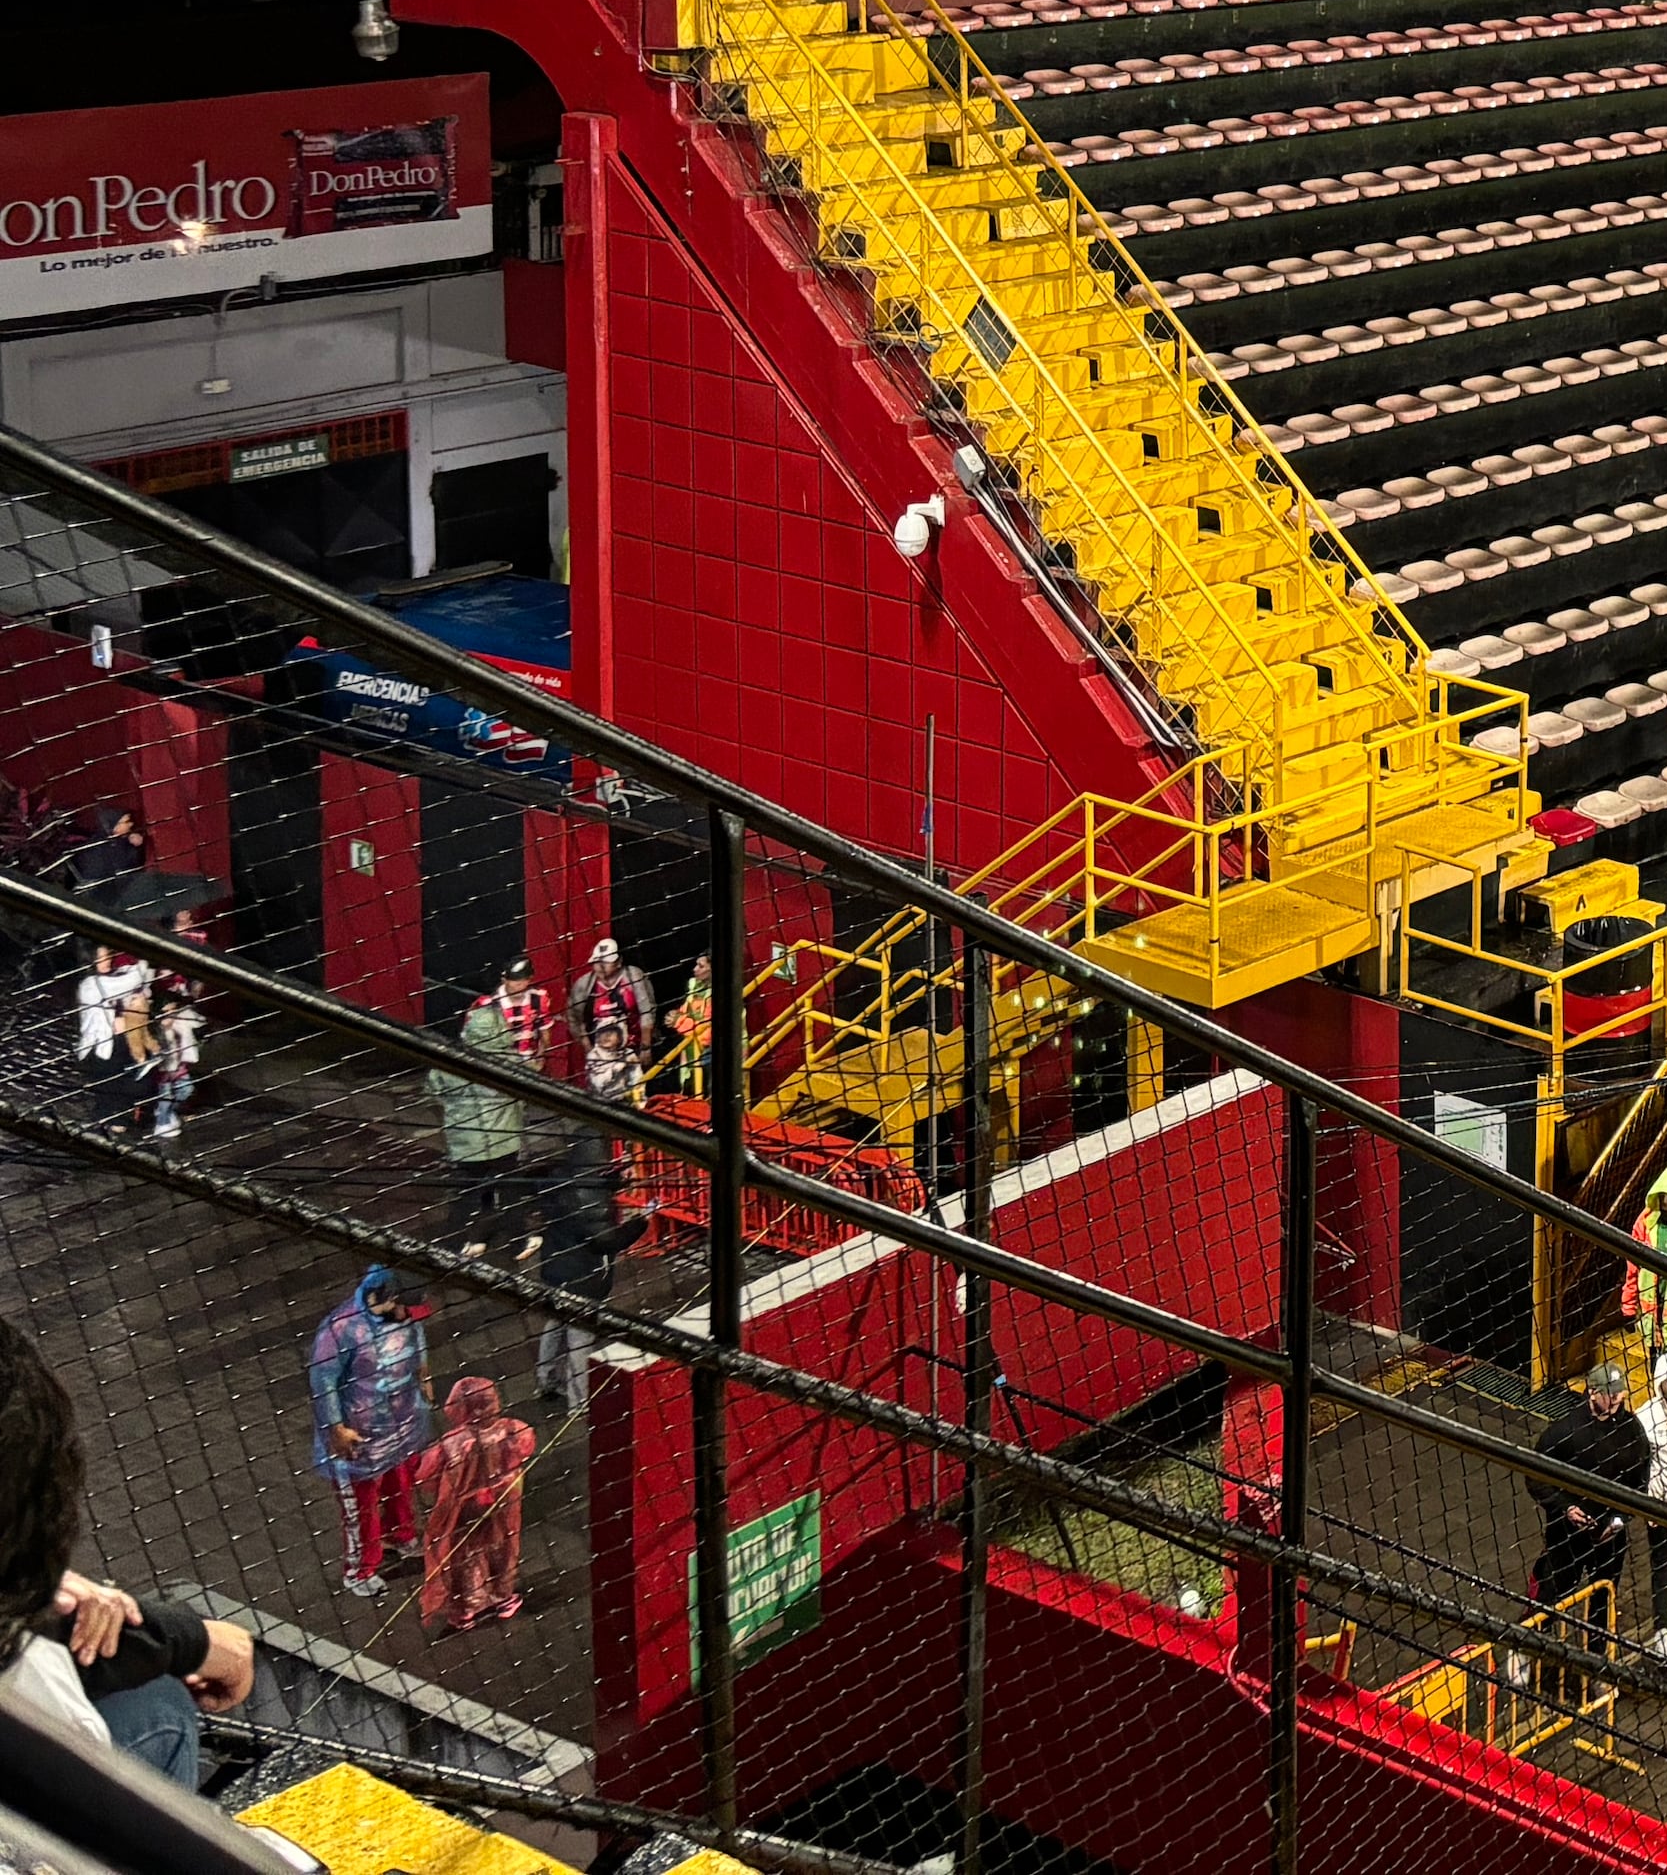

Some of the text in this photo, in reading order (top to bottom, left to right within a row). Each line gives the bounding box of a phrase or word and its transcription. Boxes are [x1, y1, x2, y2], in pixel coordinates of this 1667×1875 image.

[309, 161, 437, 196] DonPedro
[0, 160, 276, 247] onPedro
[40, 259, 67, 274] Lo
[71, 252, 134, 271] mejor
[139, 246, 166, 262] de
[241, 439, 317, 463] SALIDA DE
[232, 452, 327, 479] EMERGENCIA
